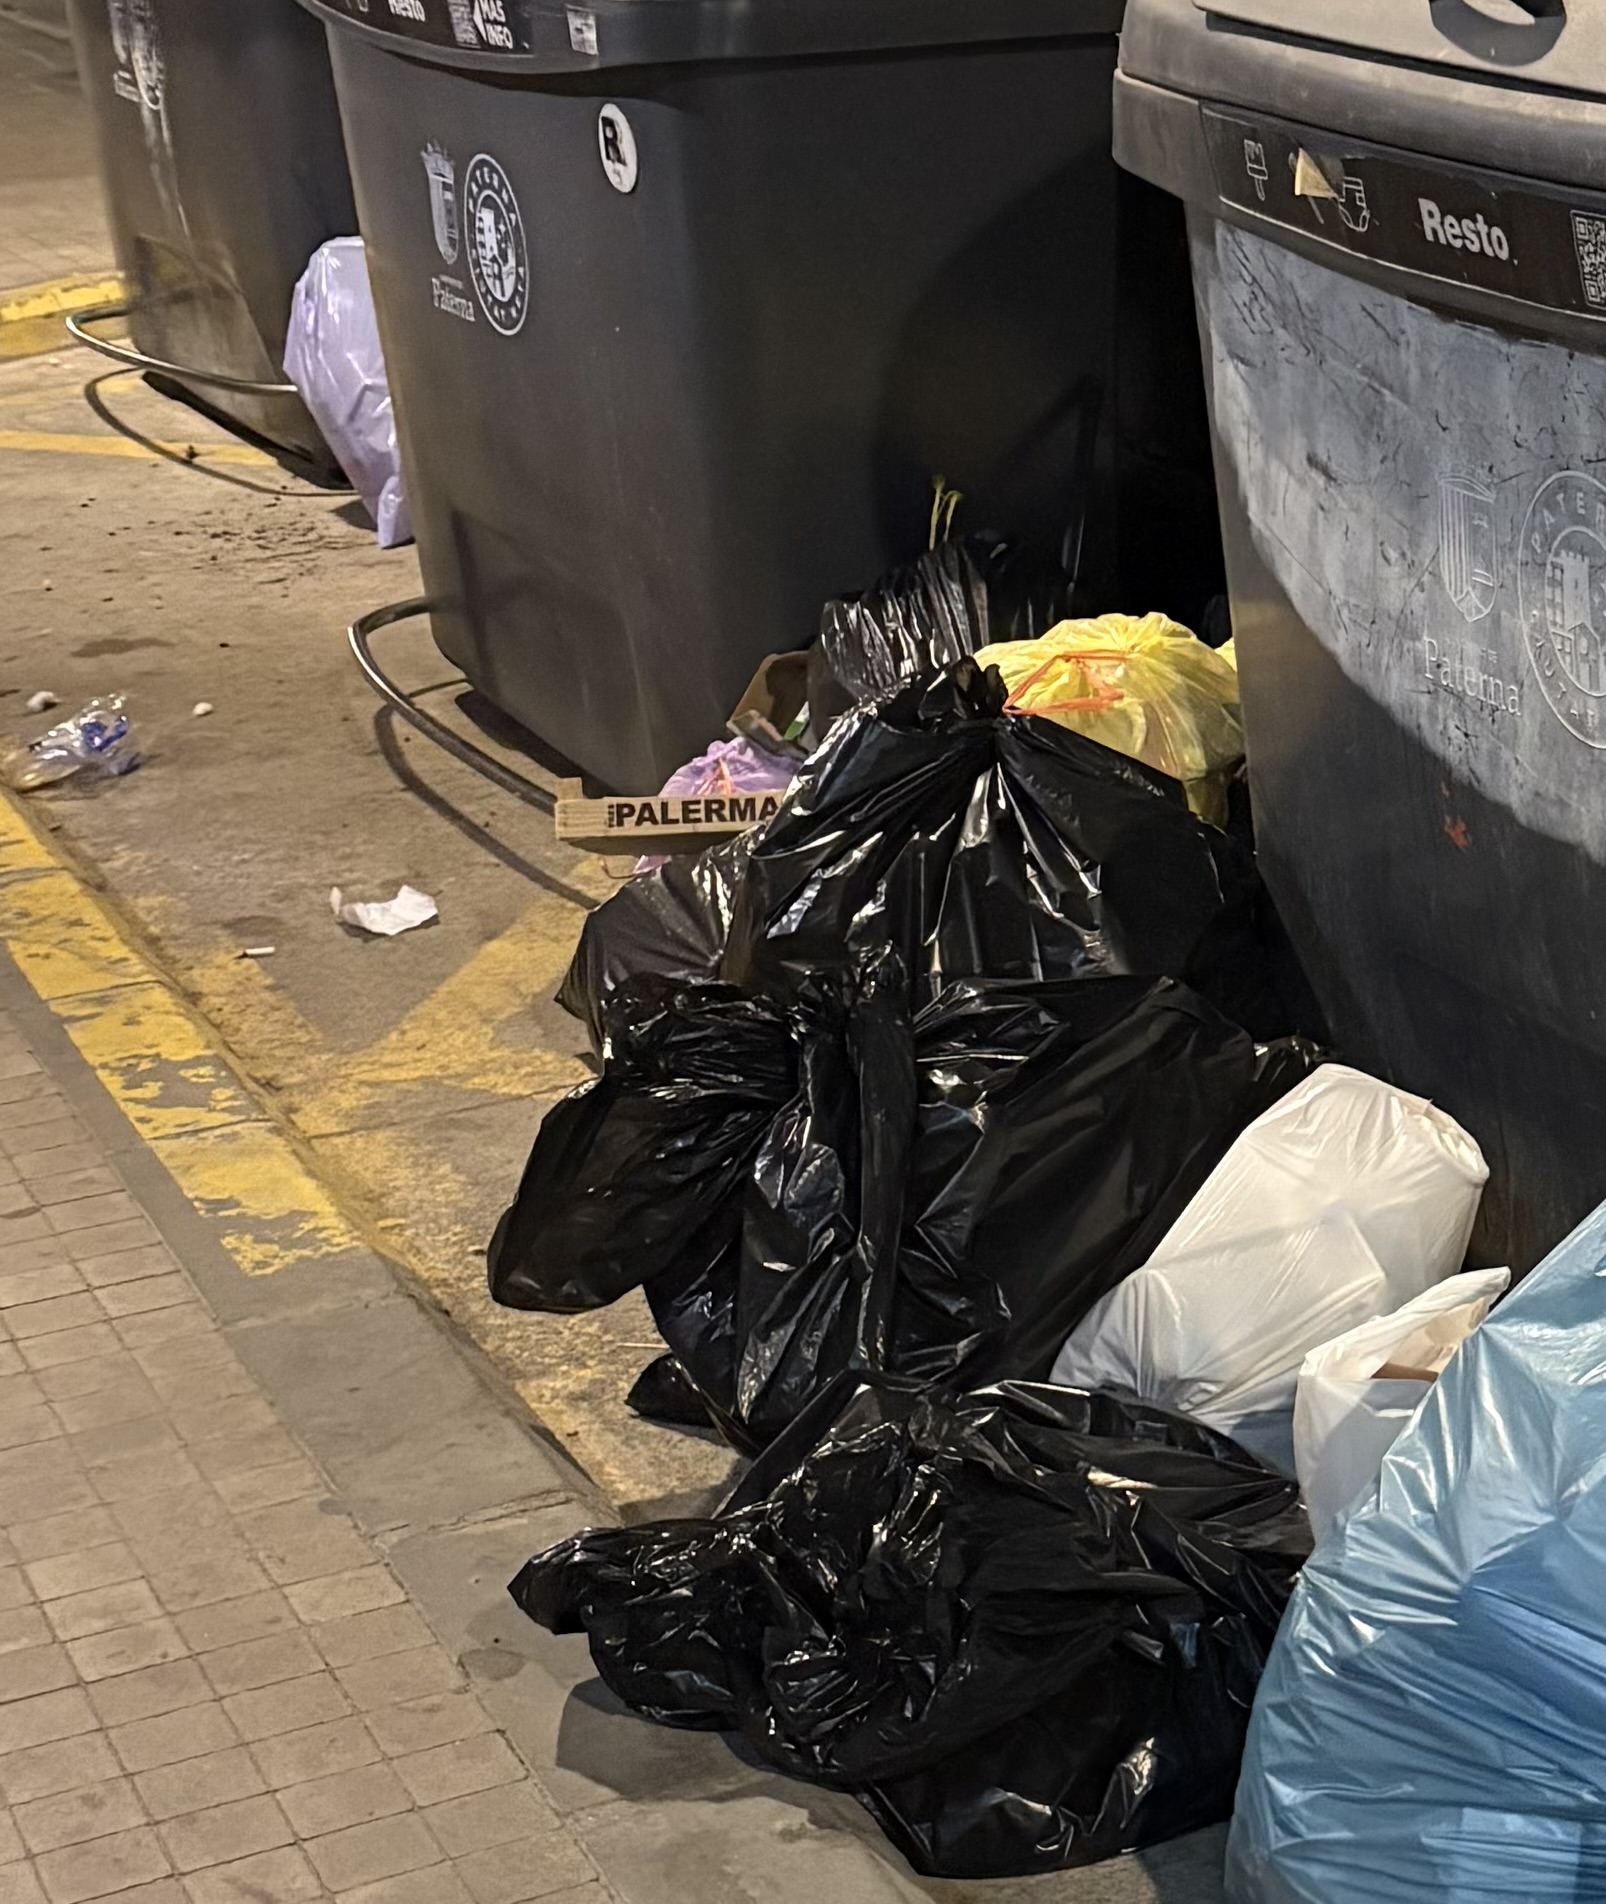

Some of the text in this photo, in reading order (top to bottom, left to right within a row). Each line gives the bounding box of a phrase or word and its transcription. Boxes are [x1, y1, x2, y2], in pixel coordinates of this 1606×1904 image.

[485, 22, 513, 49] INFO
[601, 115, 628, 167] R
[1418, 197, 1510, 261] Resto
[1423, 634, 1522, 717] Paterna
